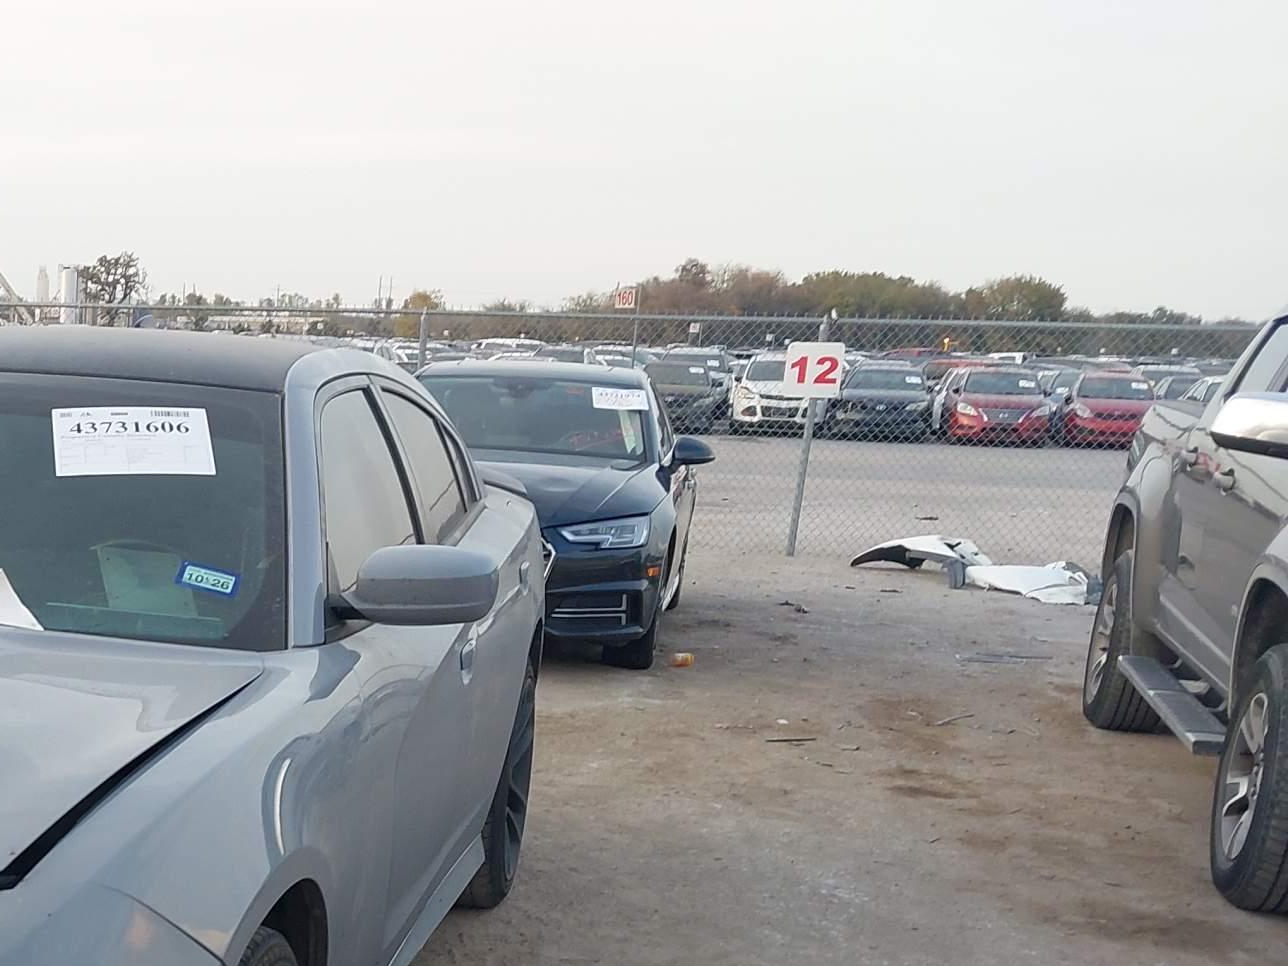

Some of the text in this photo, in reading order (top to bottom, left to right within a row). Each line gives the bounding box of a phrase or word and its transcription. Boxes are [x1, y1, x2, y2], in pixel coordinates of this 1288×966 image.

[617, 291, 633, 306] 160
[791, 355, 839, 384] 12
[69, 421, 190, 434] 43731606
[187, 572, 230, 590] 10 26
